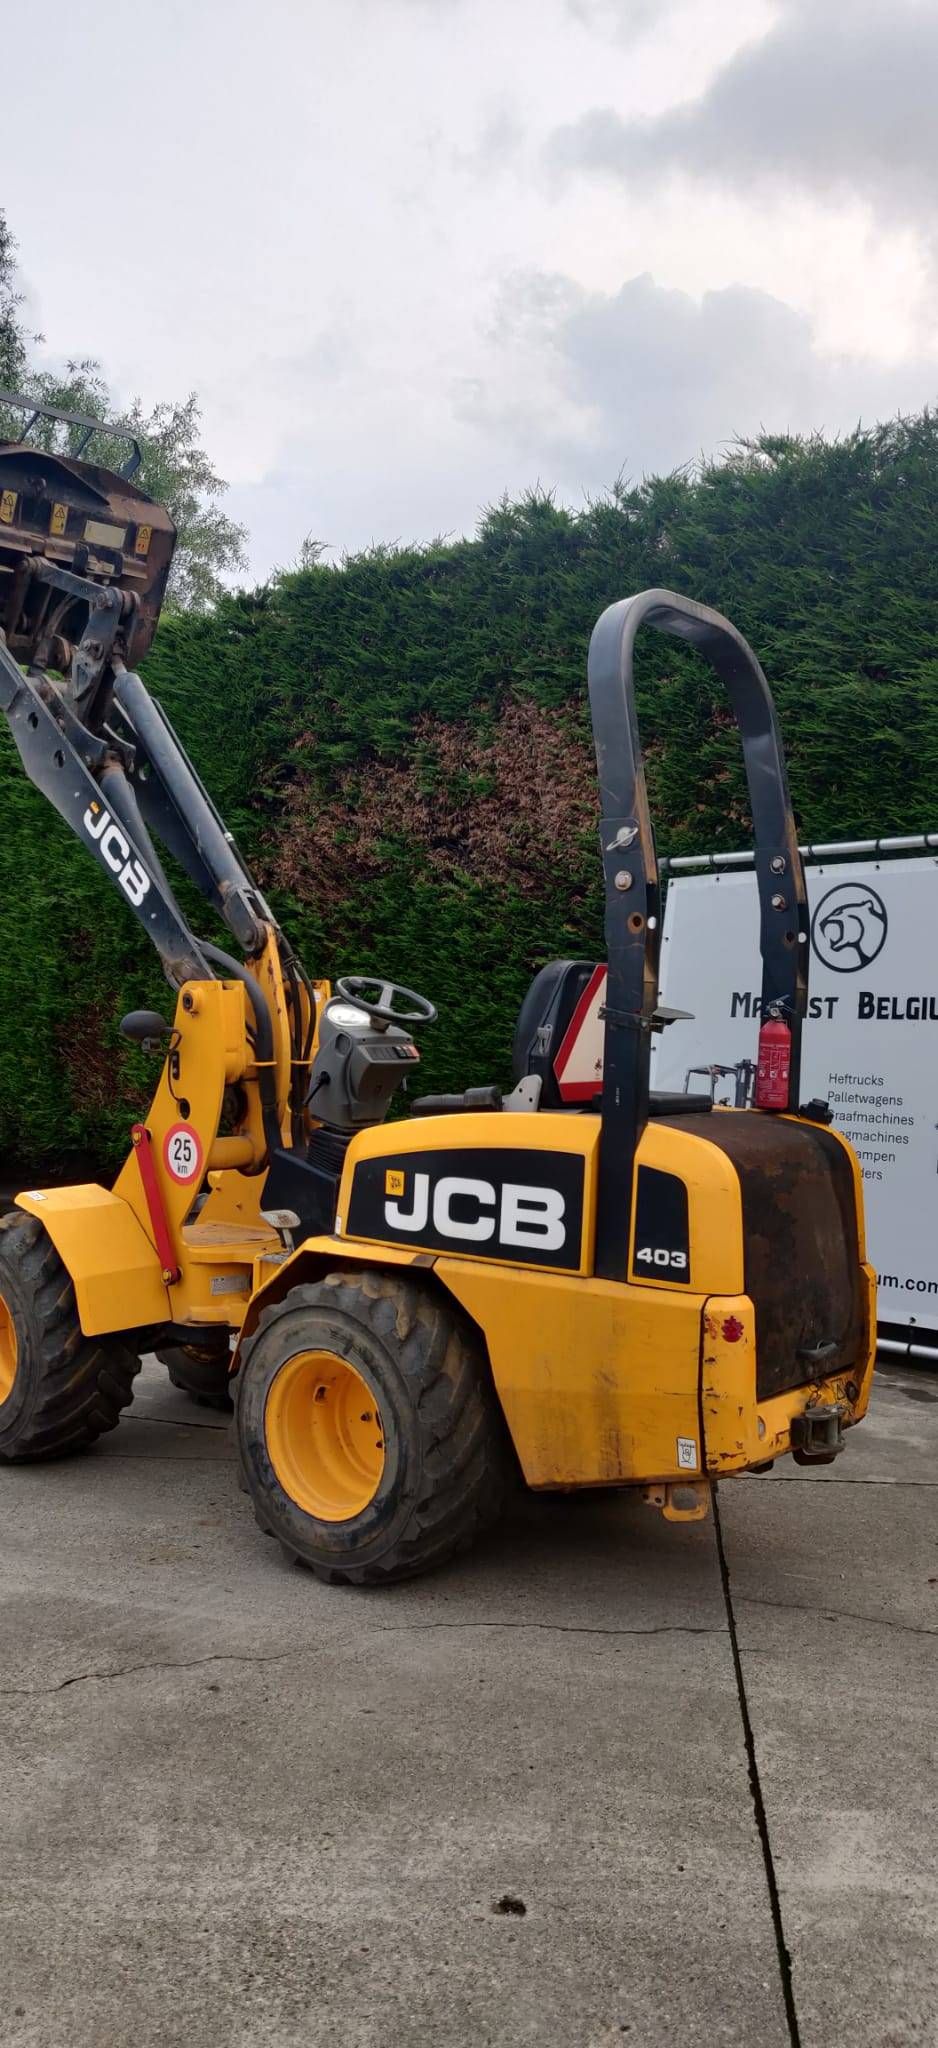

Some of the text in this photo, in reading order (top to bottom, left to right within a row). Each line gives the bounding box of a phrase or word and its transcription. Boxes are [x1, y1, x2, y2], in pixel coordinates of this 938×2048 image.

[84, 809, 150, 906] JCB
[828, 1073, 884, 1086] Heftrucks
[827, 1091, 903, 1107] Palletwagens
[174, 1138, 192, 1162] 25
[177, 1162, 188, 1174] km
[384, 1173, 566, 1250] JCB
[637, 1247, 687, 1268] 403
